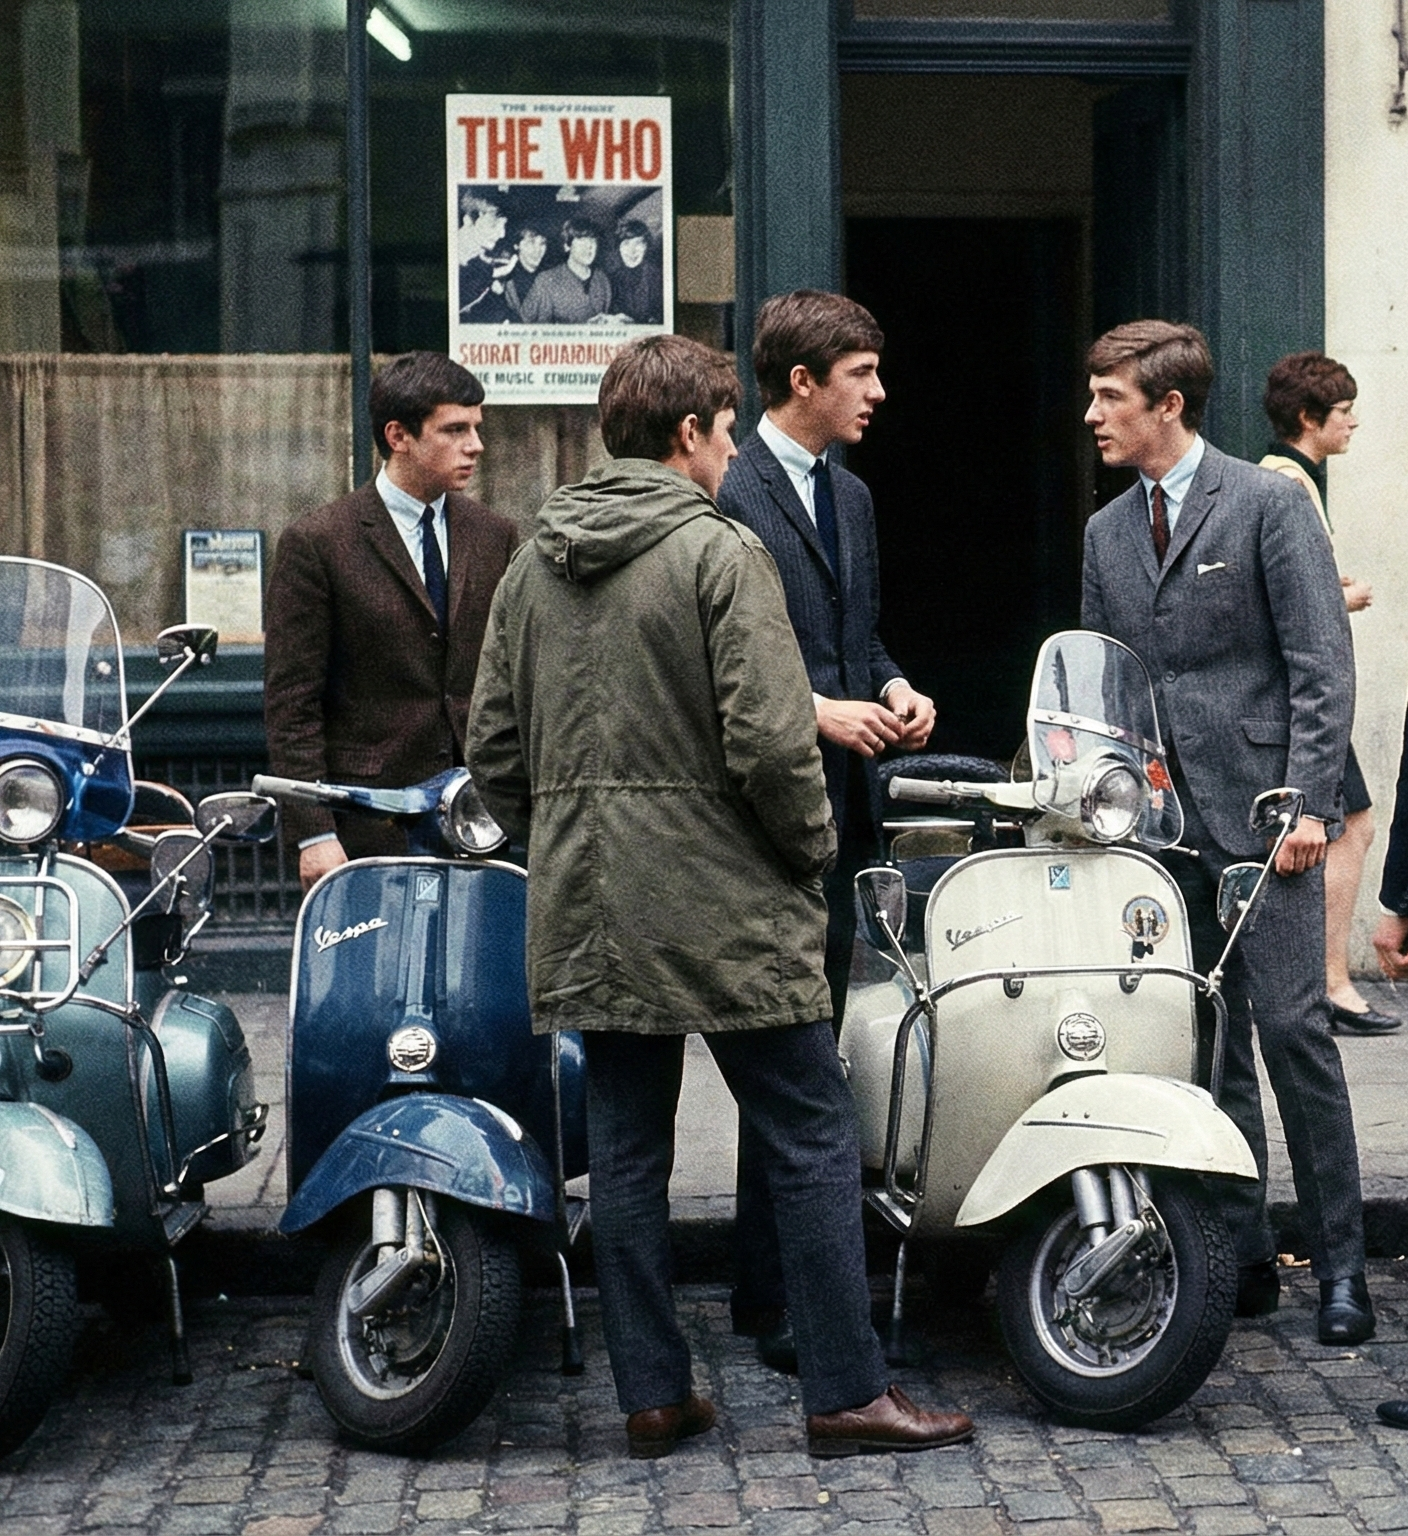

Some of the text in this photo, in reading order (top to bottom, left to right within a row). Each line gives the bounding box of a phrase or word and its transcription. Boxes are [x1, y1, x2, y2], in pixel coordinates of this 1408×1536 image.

[457, 116, 662, 181] THE WHO
[313, 917, 389, 953] Vespa
